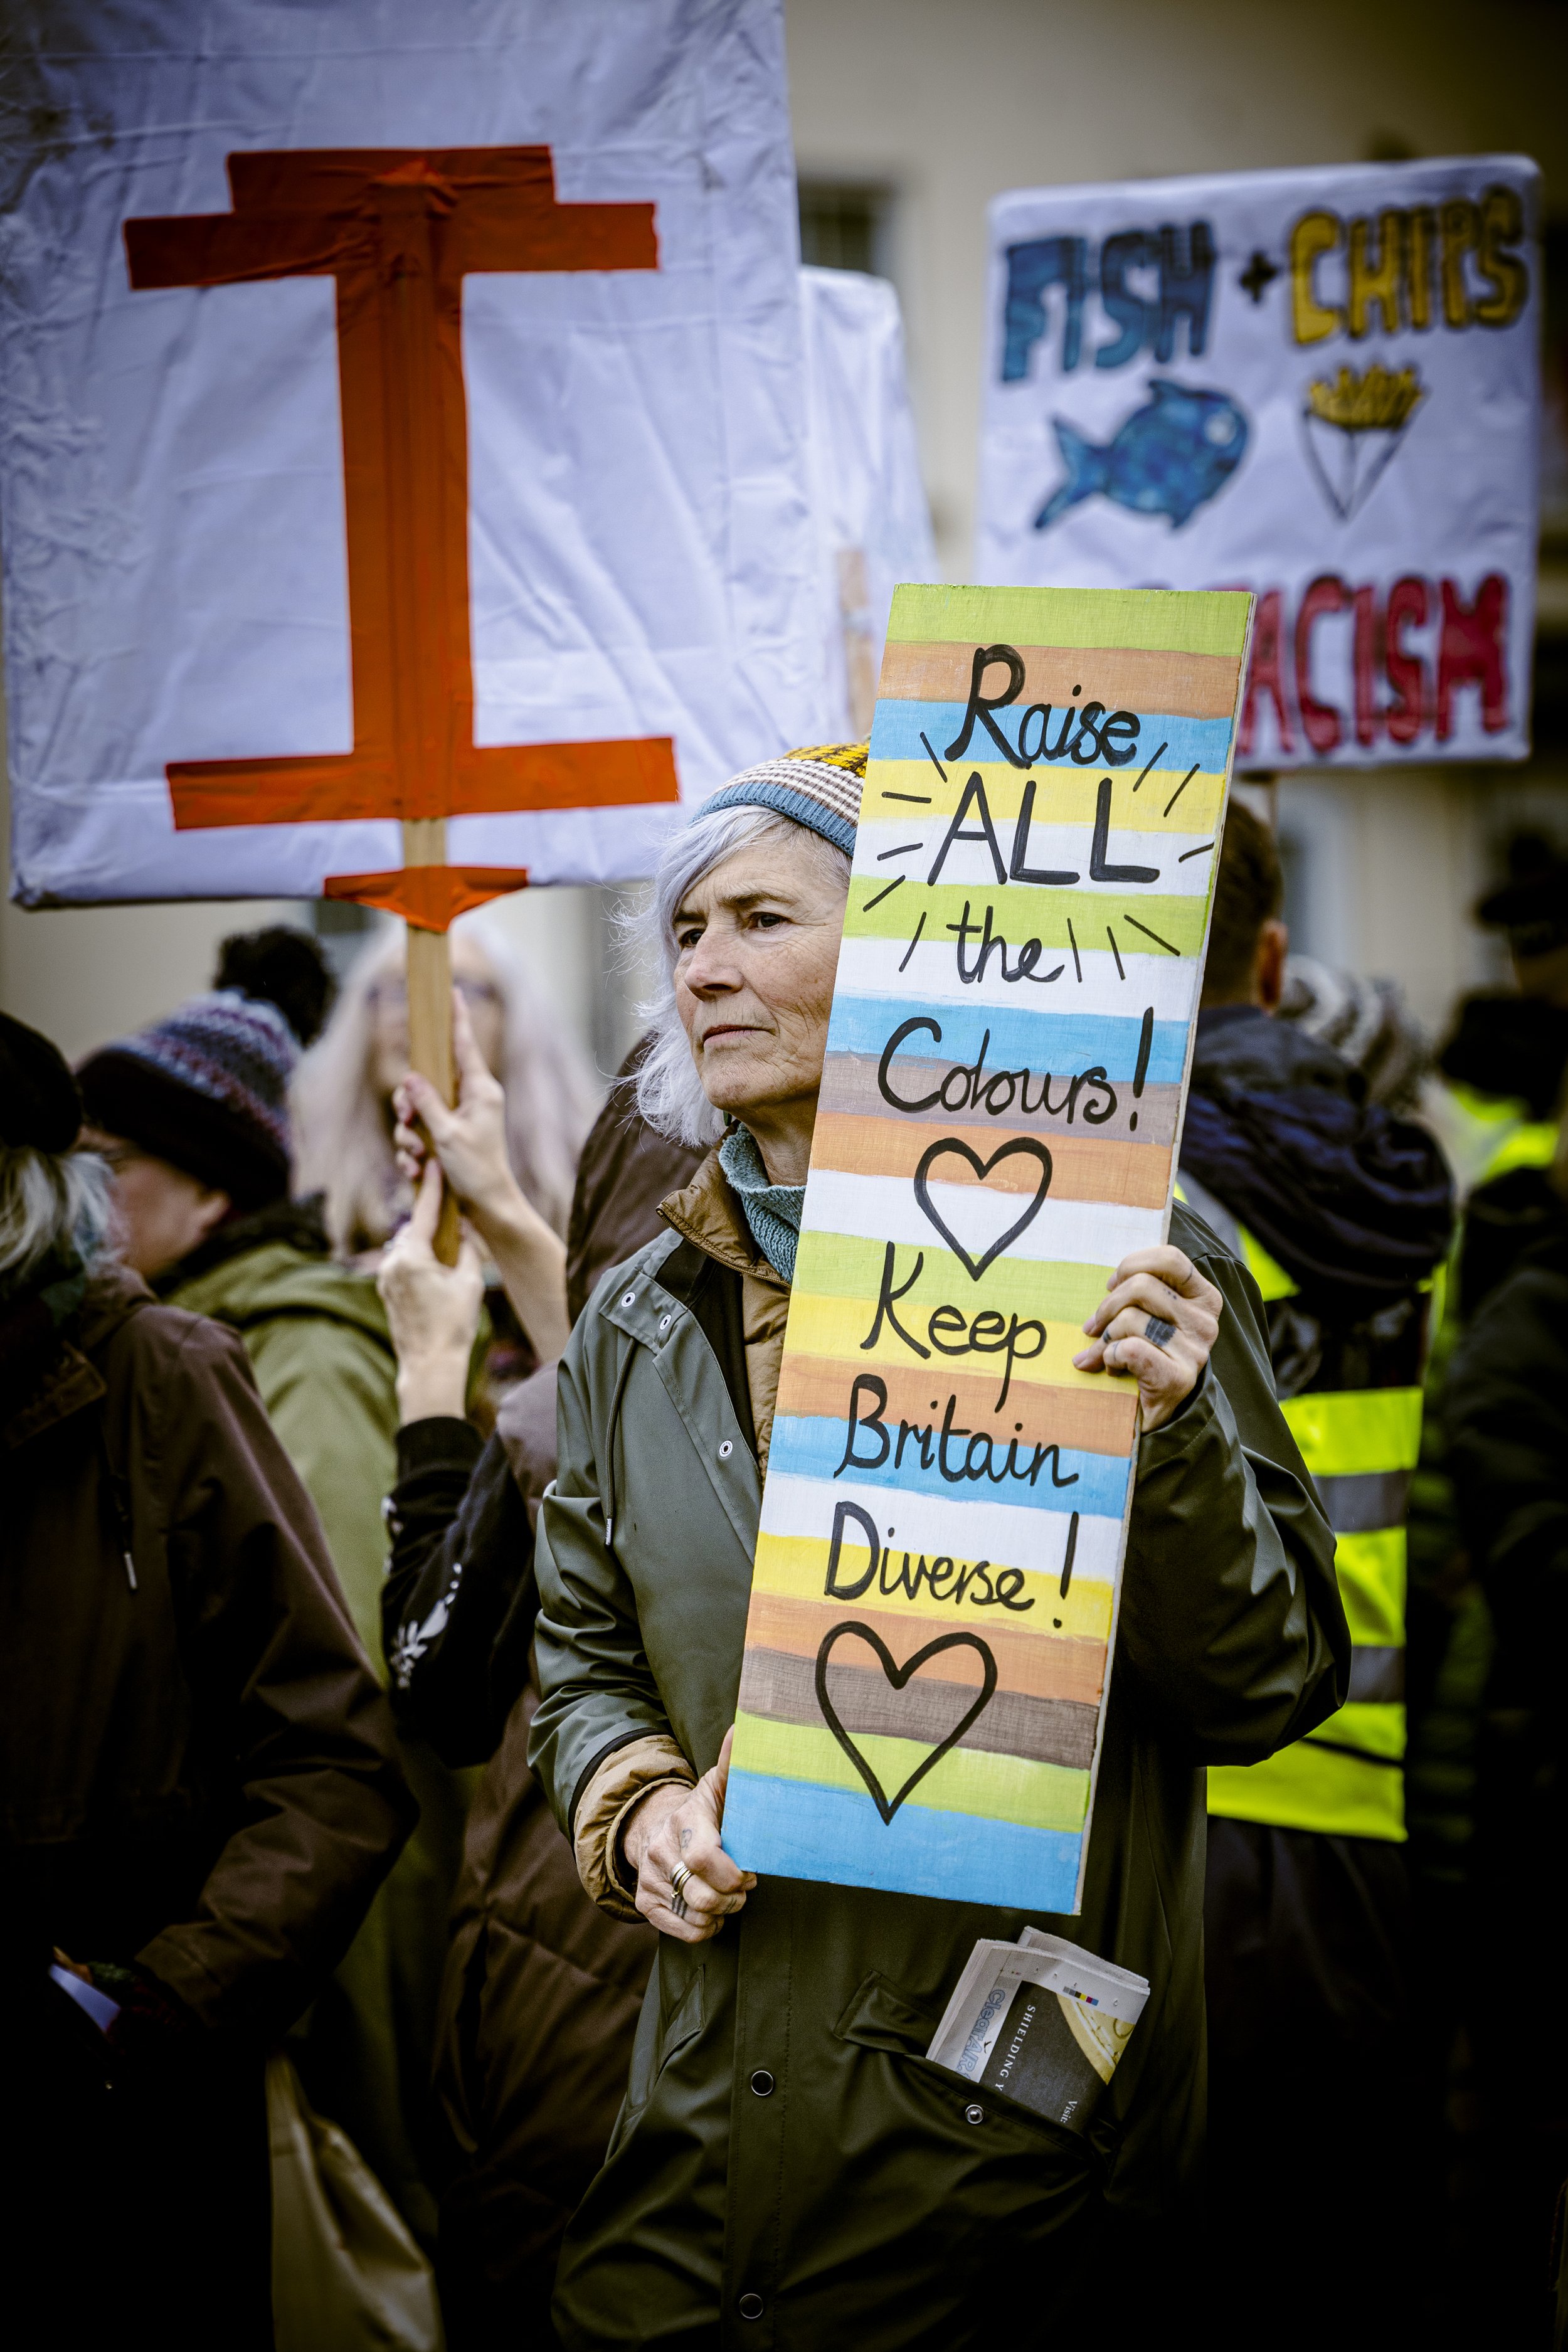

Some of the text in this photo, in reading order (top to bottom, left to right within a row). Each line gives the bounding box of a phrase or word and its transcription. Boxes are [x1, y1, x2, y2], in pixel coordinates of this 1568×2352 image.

[1000, 222, 1214, 384] FISH
[1290, 187, 1528, 345] CHIPS
[944, 644, 1140, 770] Raise
[1199, 572, 1509, 756] ACISM
[927, 771, 1160, 886] ALL
[946, 900, 1065, 983] the
[877, 1006, 1154, 1131] Colours!
[859, 1241, 1047, 1412] Keep
[834, 1374, 1079, 1488] Britain
[1000, 2005, 1036, 2078] SHIELDING
